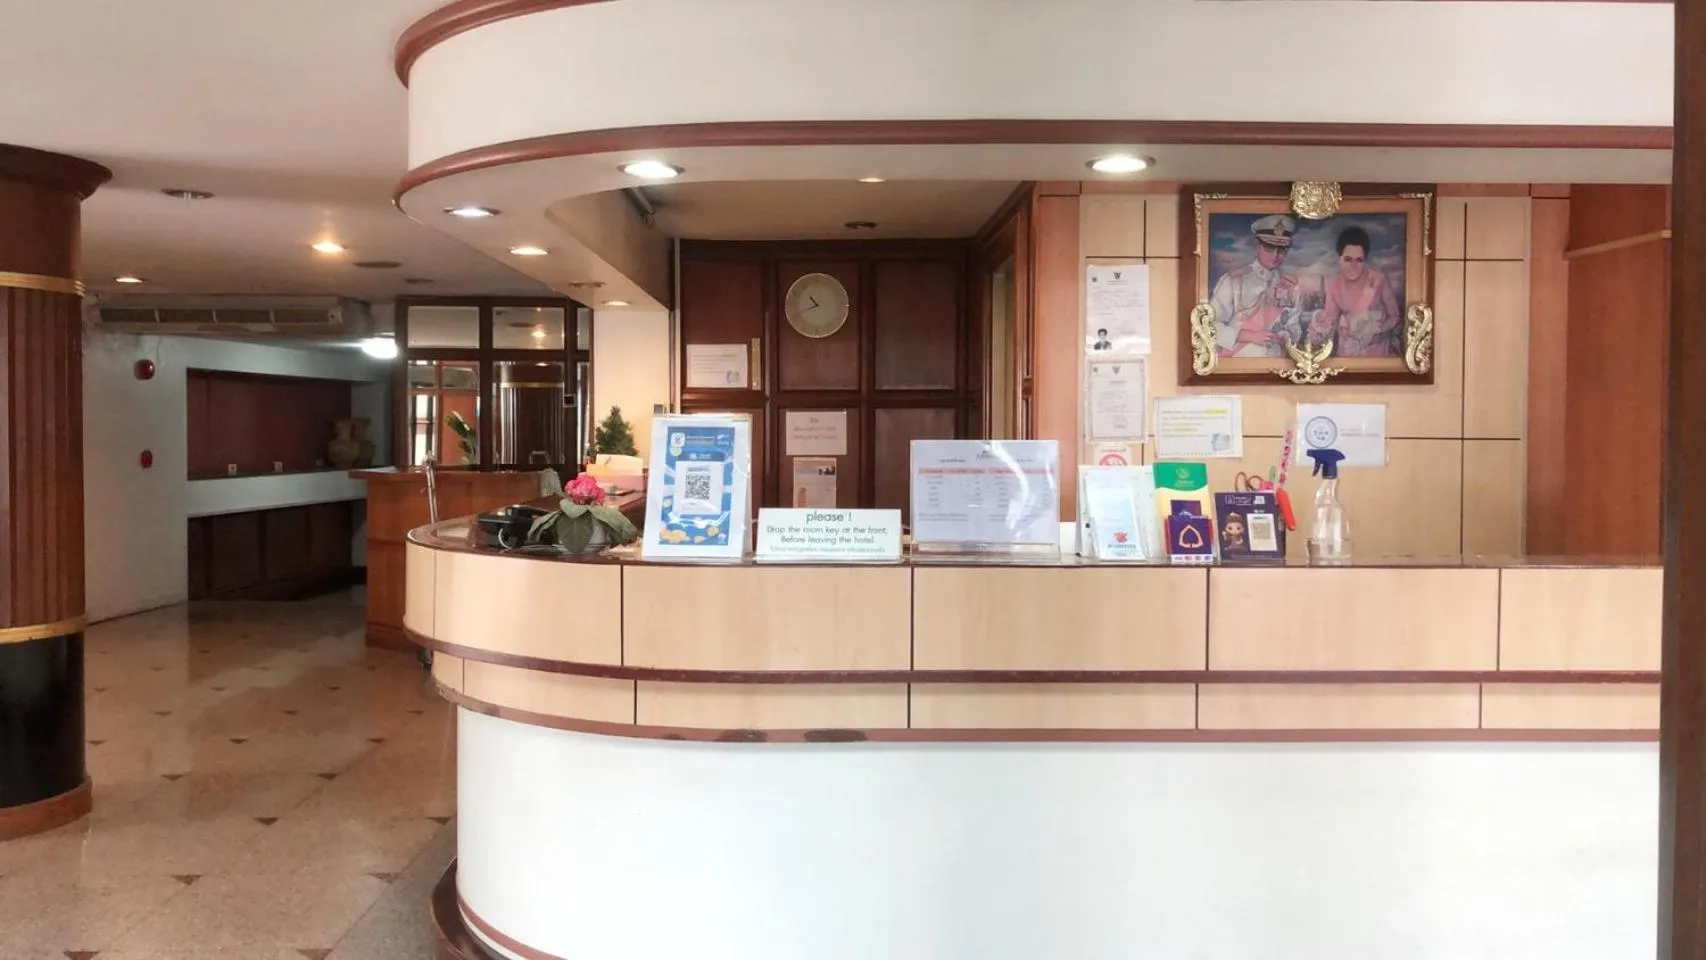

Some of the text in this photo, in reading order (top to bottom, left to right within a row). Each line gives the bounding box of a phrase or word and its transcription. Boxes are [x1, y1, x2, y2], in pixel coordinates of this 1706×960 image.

[806, 510, 844, 524] please
[767, 526, 785, 534] Drop
[788, 525, 801, 533] the
[825, 526, 839, 535] key
[807, 535, 837, 545] leaving
